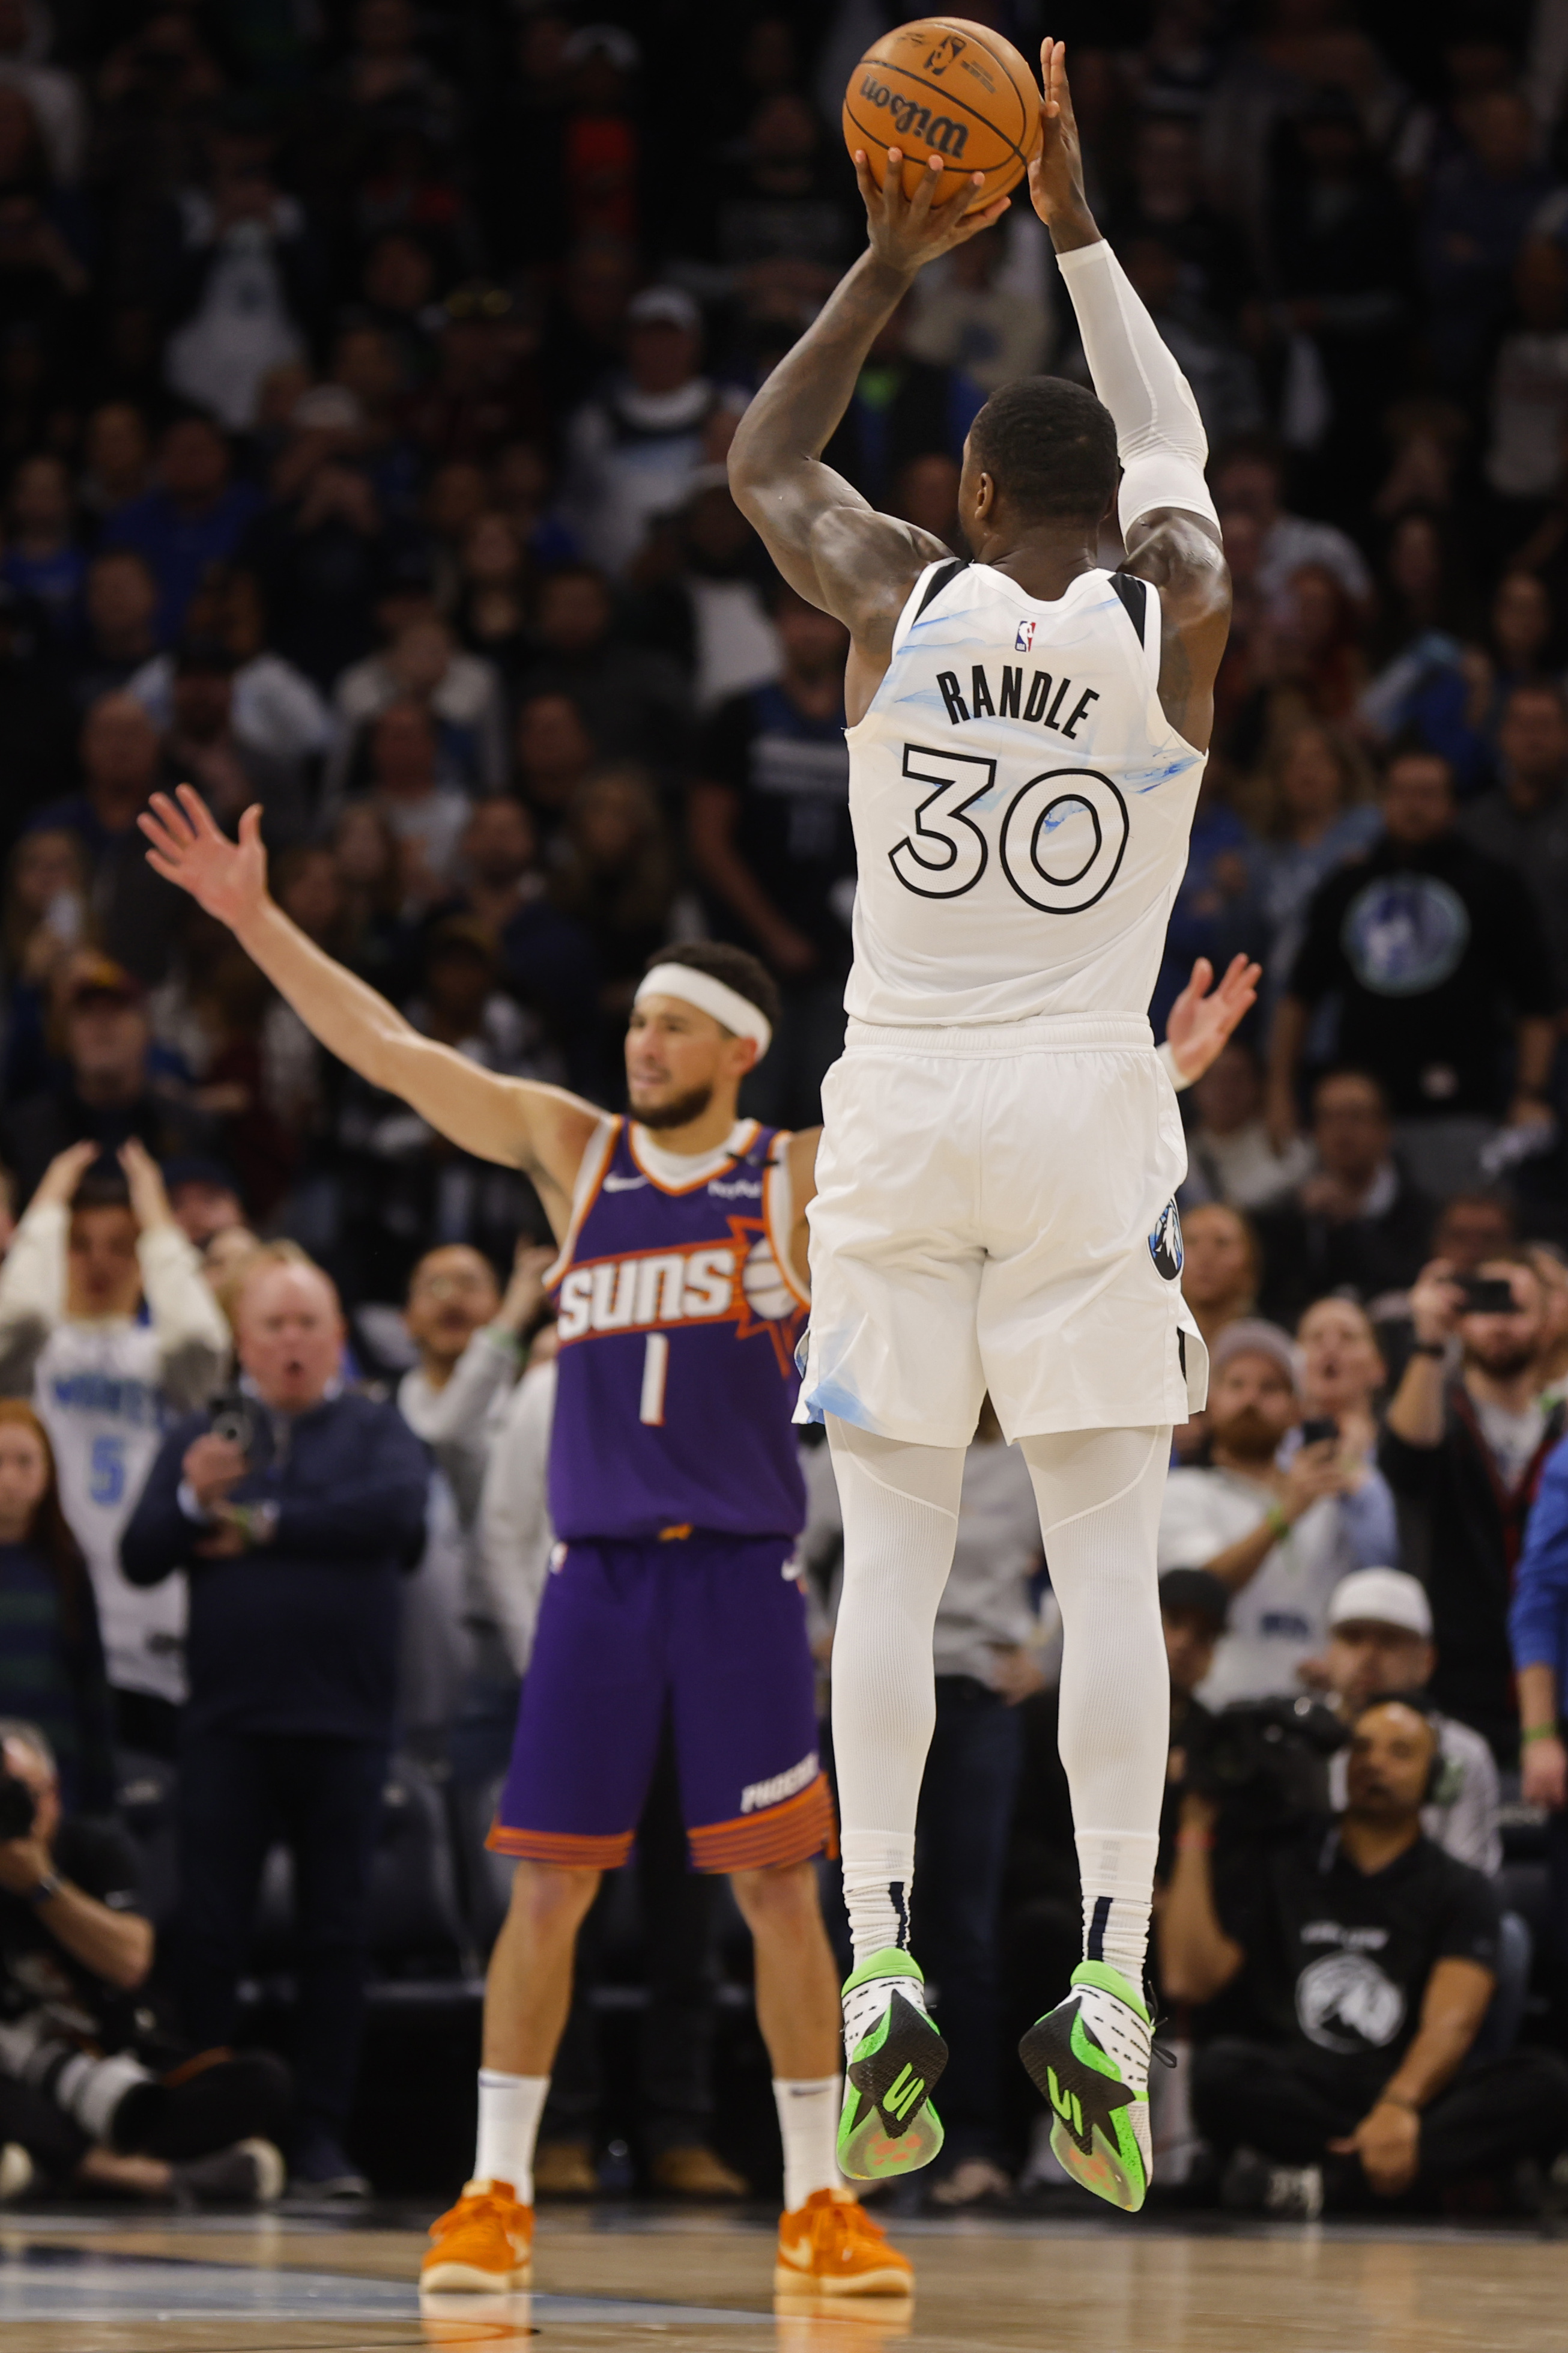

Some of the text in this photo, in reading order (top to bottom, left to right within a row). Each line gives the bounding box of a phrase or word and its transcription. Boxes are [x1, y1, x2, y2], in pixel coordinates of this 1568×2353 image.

[860, 73, 969, 159] Wilson
[937, 664, 1100, 739] RANDLE
[888, 743, 1129, 915] 30
[557, 1247, 736, 1340] SUNS
[640, 1332, 668, 1426] 1
